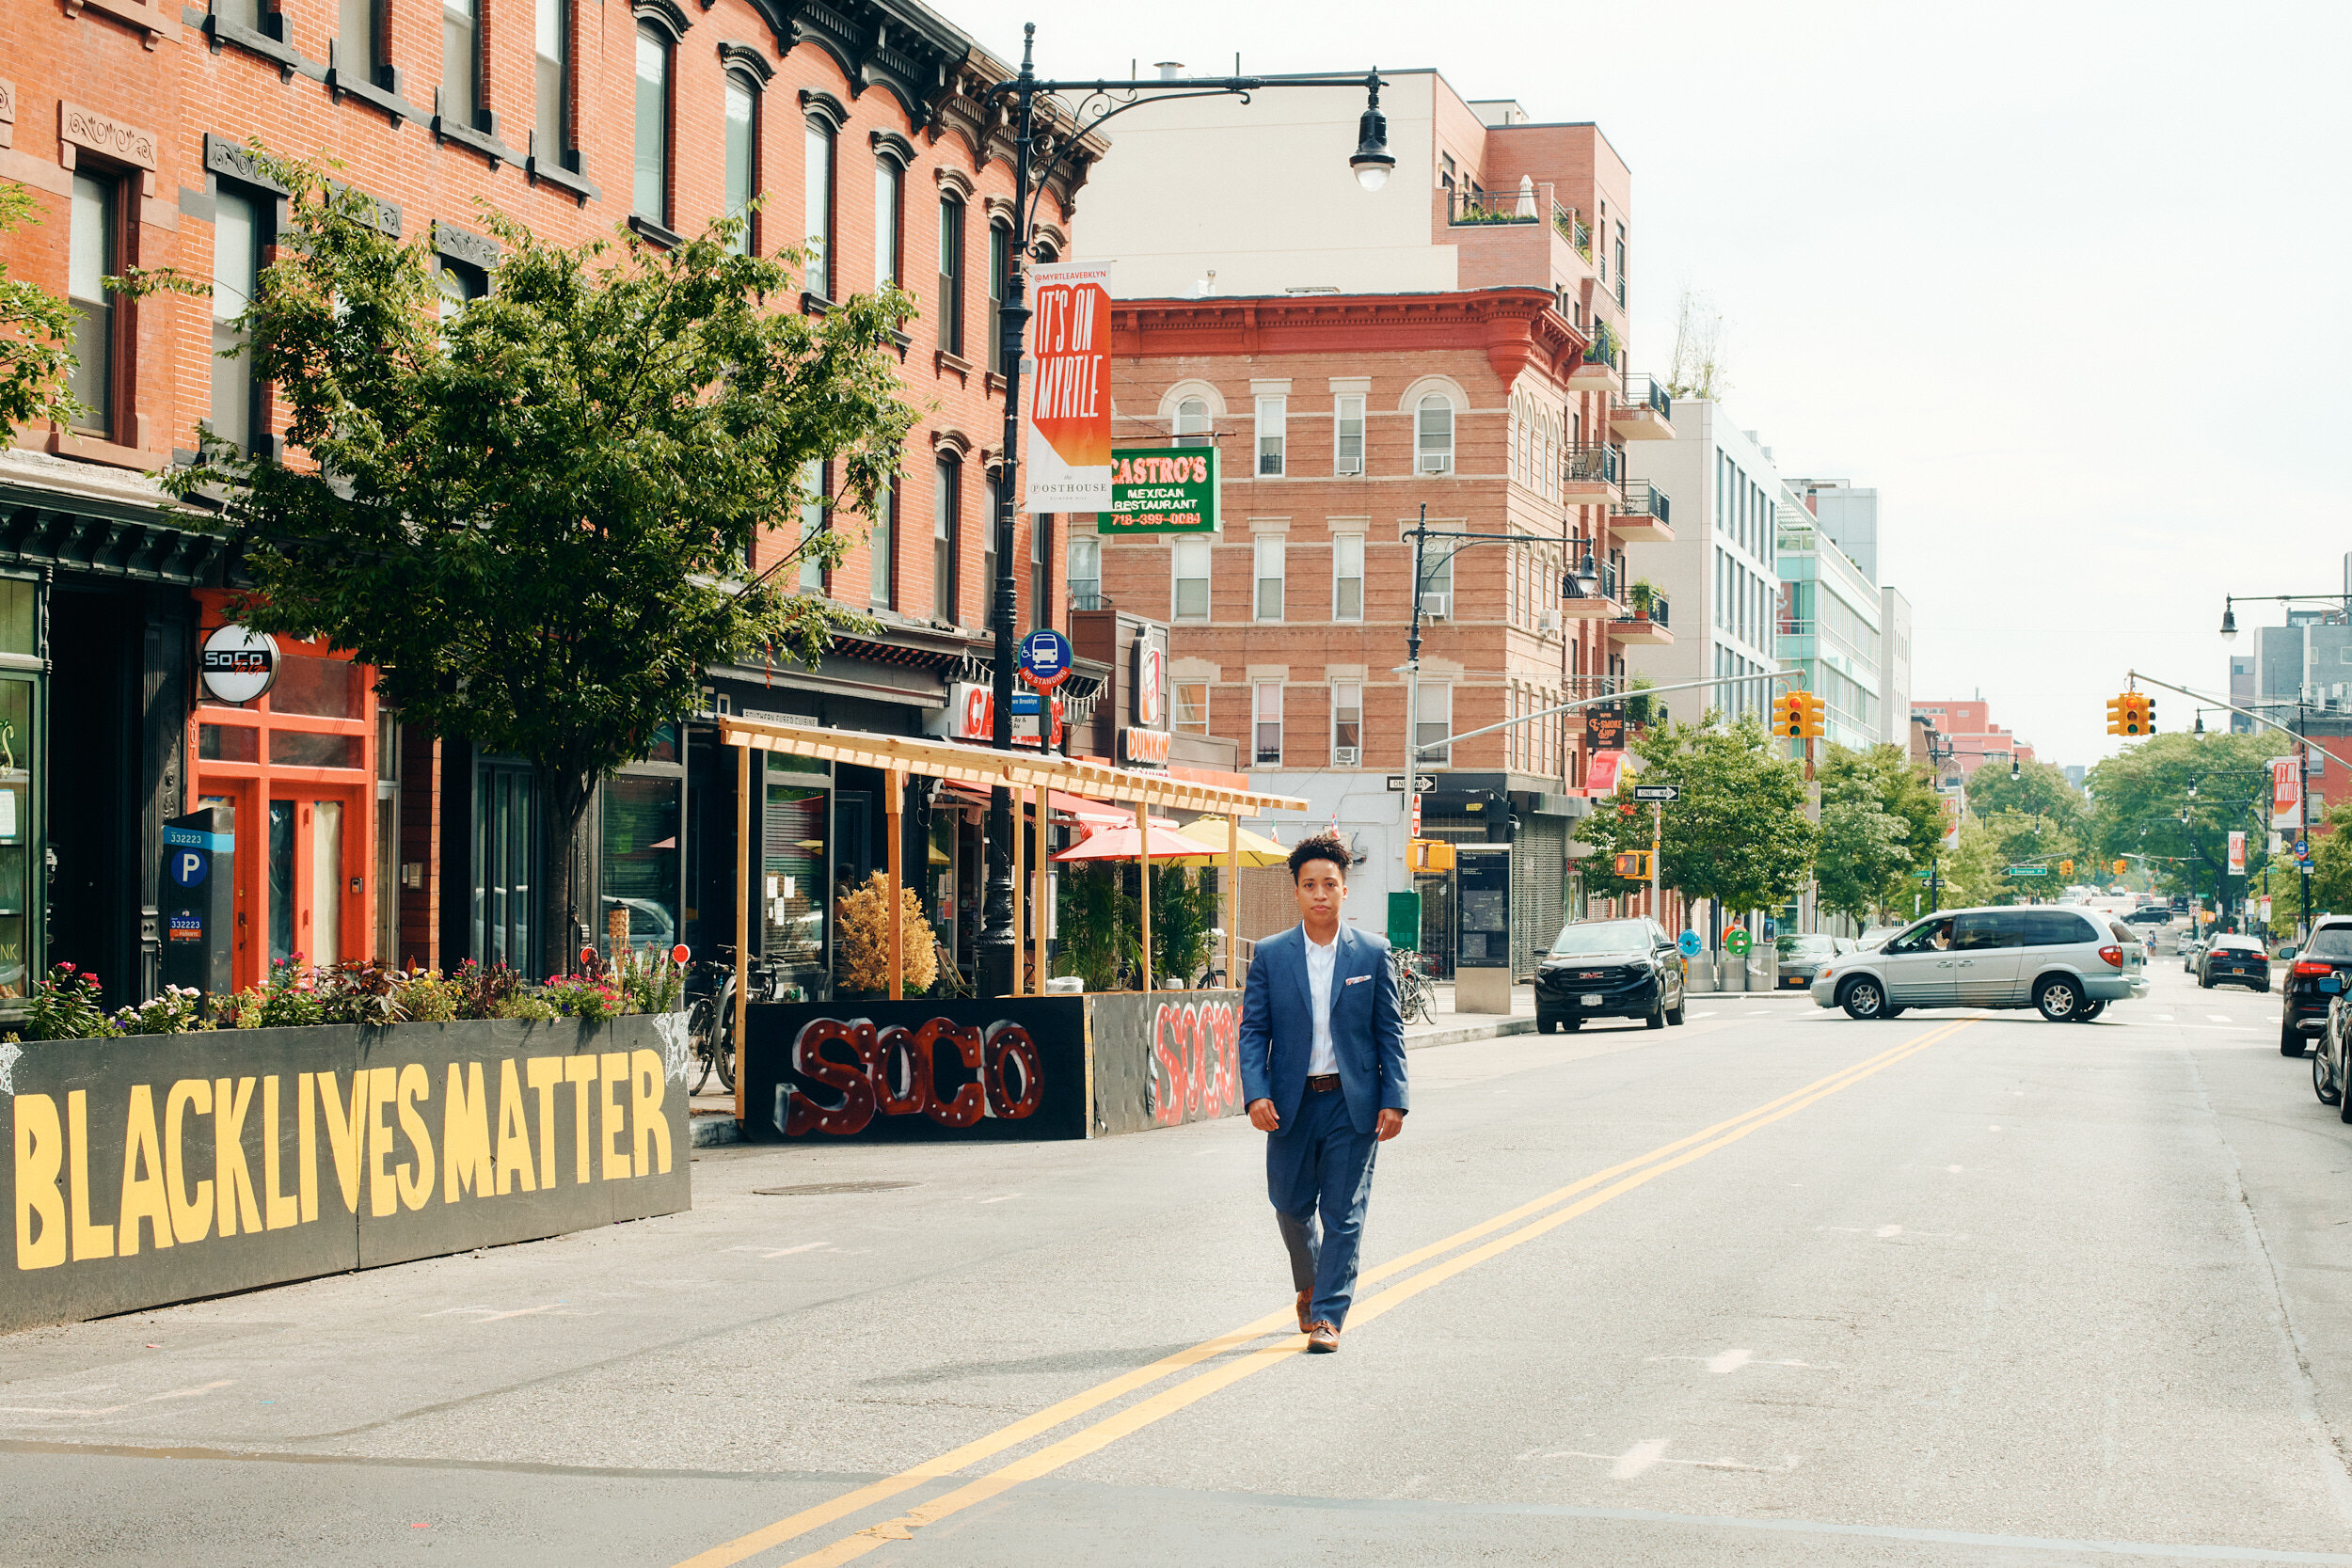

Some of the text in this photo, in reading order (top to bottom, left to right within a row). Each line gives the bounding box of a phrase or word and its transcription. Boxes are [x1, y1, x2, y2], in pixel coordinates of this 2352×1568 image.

[1034, 270, 1106, 283] @MYRTLEAVEBKLYN
[1038, 288, 1096, 354] IT'S ON
[1036, 355, 1104, 420] MYRTLE
[1033, 483, 1107, 493] POSTHOUSE
[1127, 488, 1184, 499] MEXICAN
[1114, 499, 1199, 510] RESTAURANT
[1110, 512, 1202, 526] 718-399-0084
[230, 659, 269, 677] To Go
[1023, 668, 1069, 686] NO STANDING
[1128, 728, 1171, 764] DUNKIN'
[170, 834, 201, 844] 332223
[183, 853, 200, 882] P
[171, 921, 200, 929] 332223
[1154, 1000, 1236, 1127] SOCO
[772, 1016, 1045, 1136] SOCO
[13, 1048, 673, 1271] BLACK LIVES MATTER
